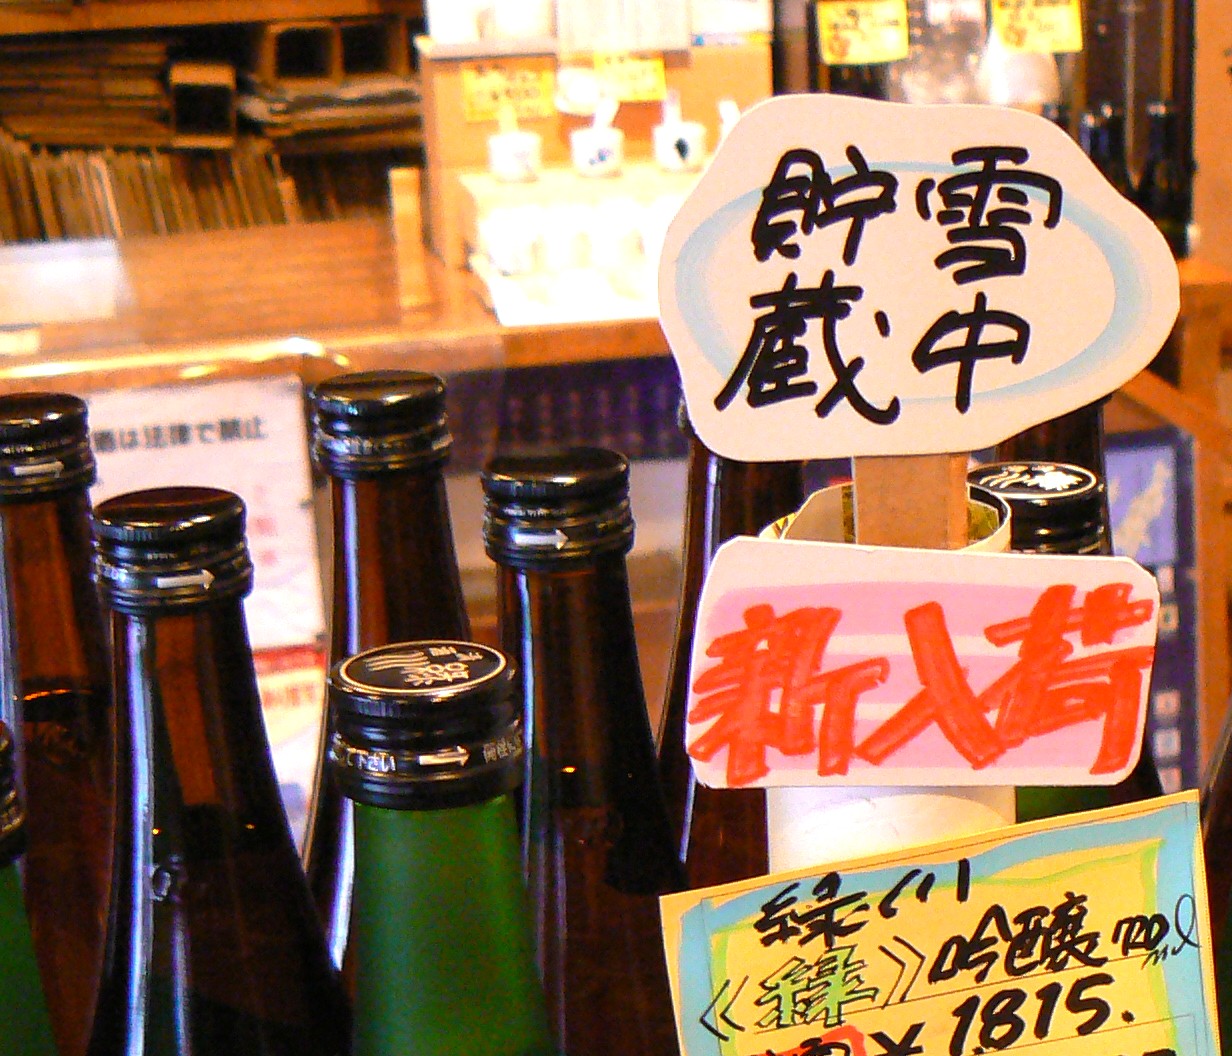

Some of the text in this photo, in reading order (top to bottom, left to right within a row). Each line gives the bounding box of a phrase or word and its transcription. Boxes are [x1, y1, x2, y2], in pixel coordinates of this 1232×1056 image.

[713, 144, 901, 426] 貯蔵
[911, 145, 1064, 414] 雪中
[688, 582, 1156, 787] 新入荷
